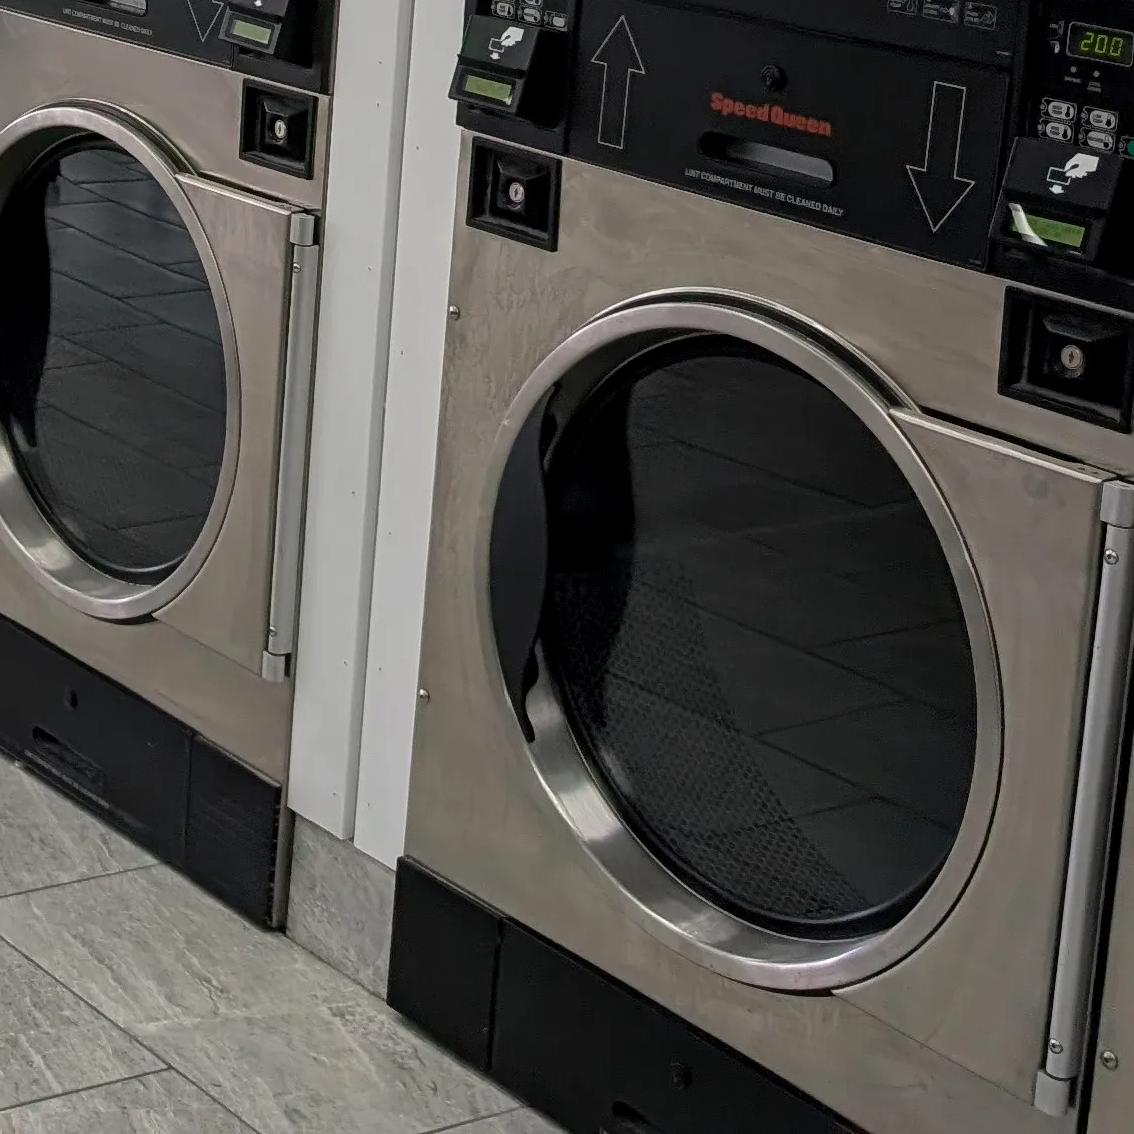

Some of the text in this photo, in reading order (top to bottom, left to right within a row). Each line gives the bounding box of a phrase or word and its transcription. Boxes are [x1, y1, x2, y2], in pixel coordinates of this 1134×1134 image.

[1080, 31, 1124, 57] 200
[710, 91, 832, 137] Speed Queen
[786, 194, 822, 211] CLEANED
[822, 202, 845, 216] DAILY
